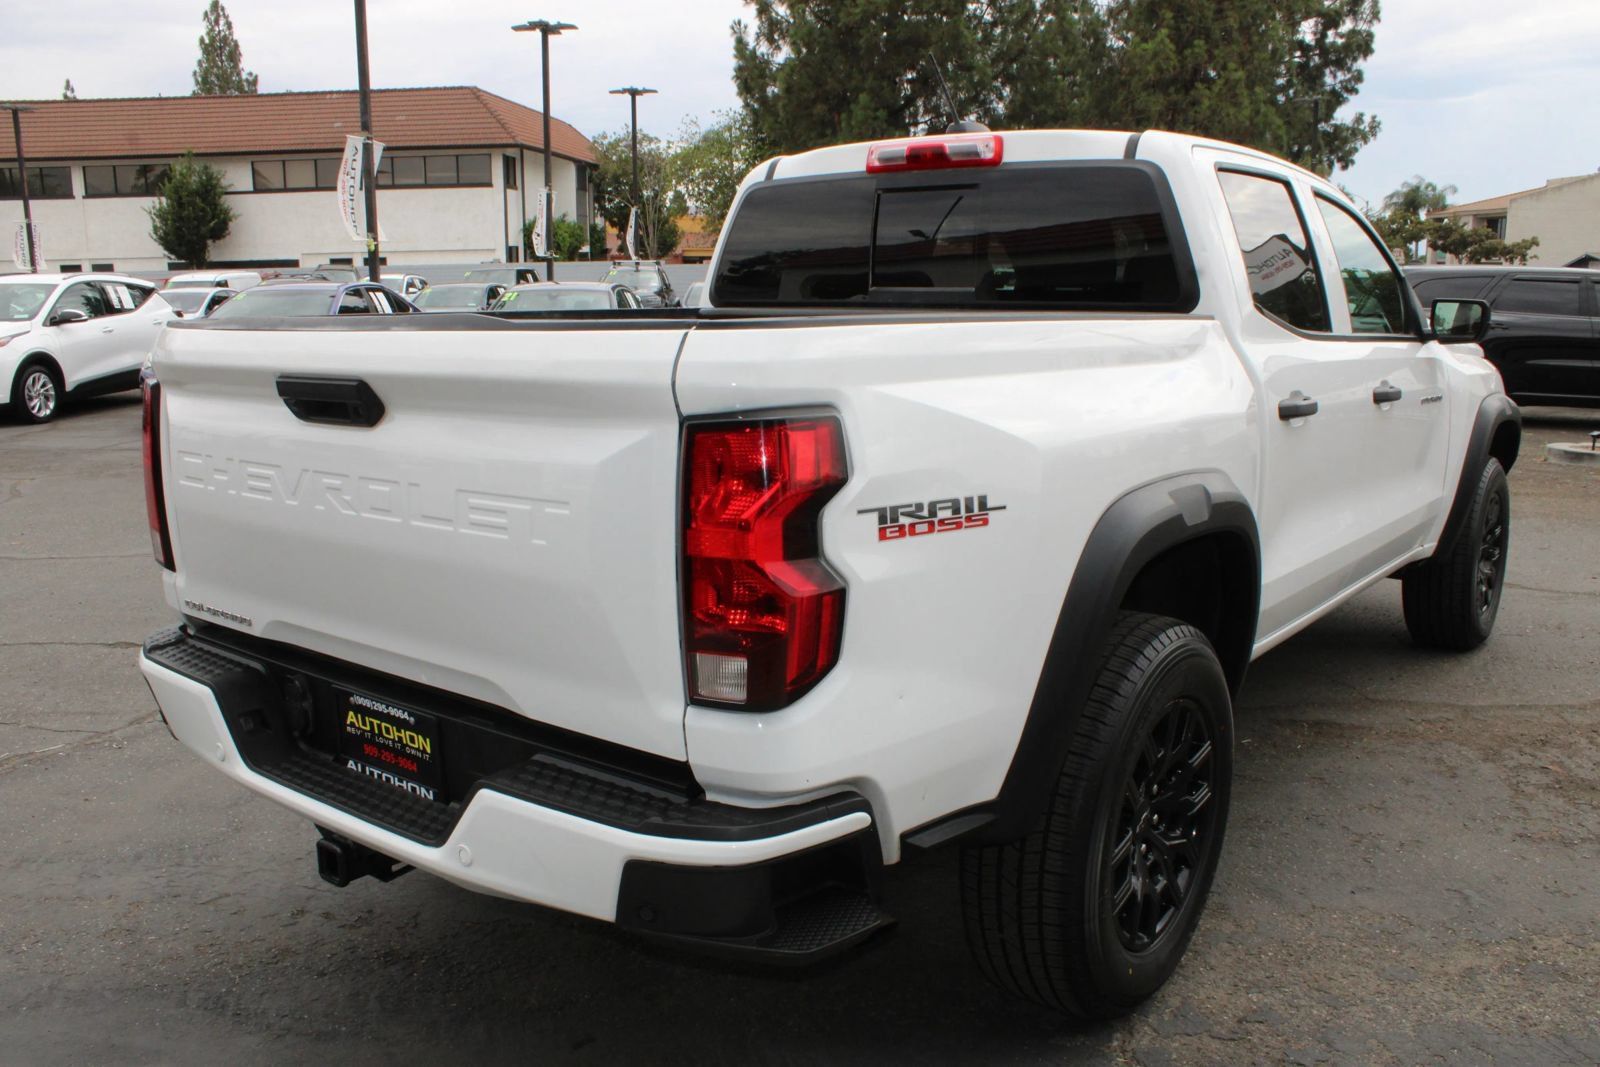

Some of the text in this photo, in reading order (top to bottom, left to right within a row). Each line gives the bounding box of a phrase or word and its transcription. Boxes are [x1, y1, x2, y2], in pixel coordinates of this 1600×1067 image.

[348, 145, 359, 236] AUTOHON
[177, 450, 571, 545] CHEVROLET
[857, 494, 1007, 526] TRAIL
[878, 512, 990, 542] BOSS
[346, 710, 431, 754] AUTOHON
[375, 735, 393, 748] LOVE
[405, 746, 422, 758] OWN
